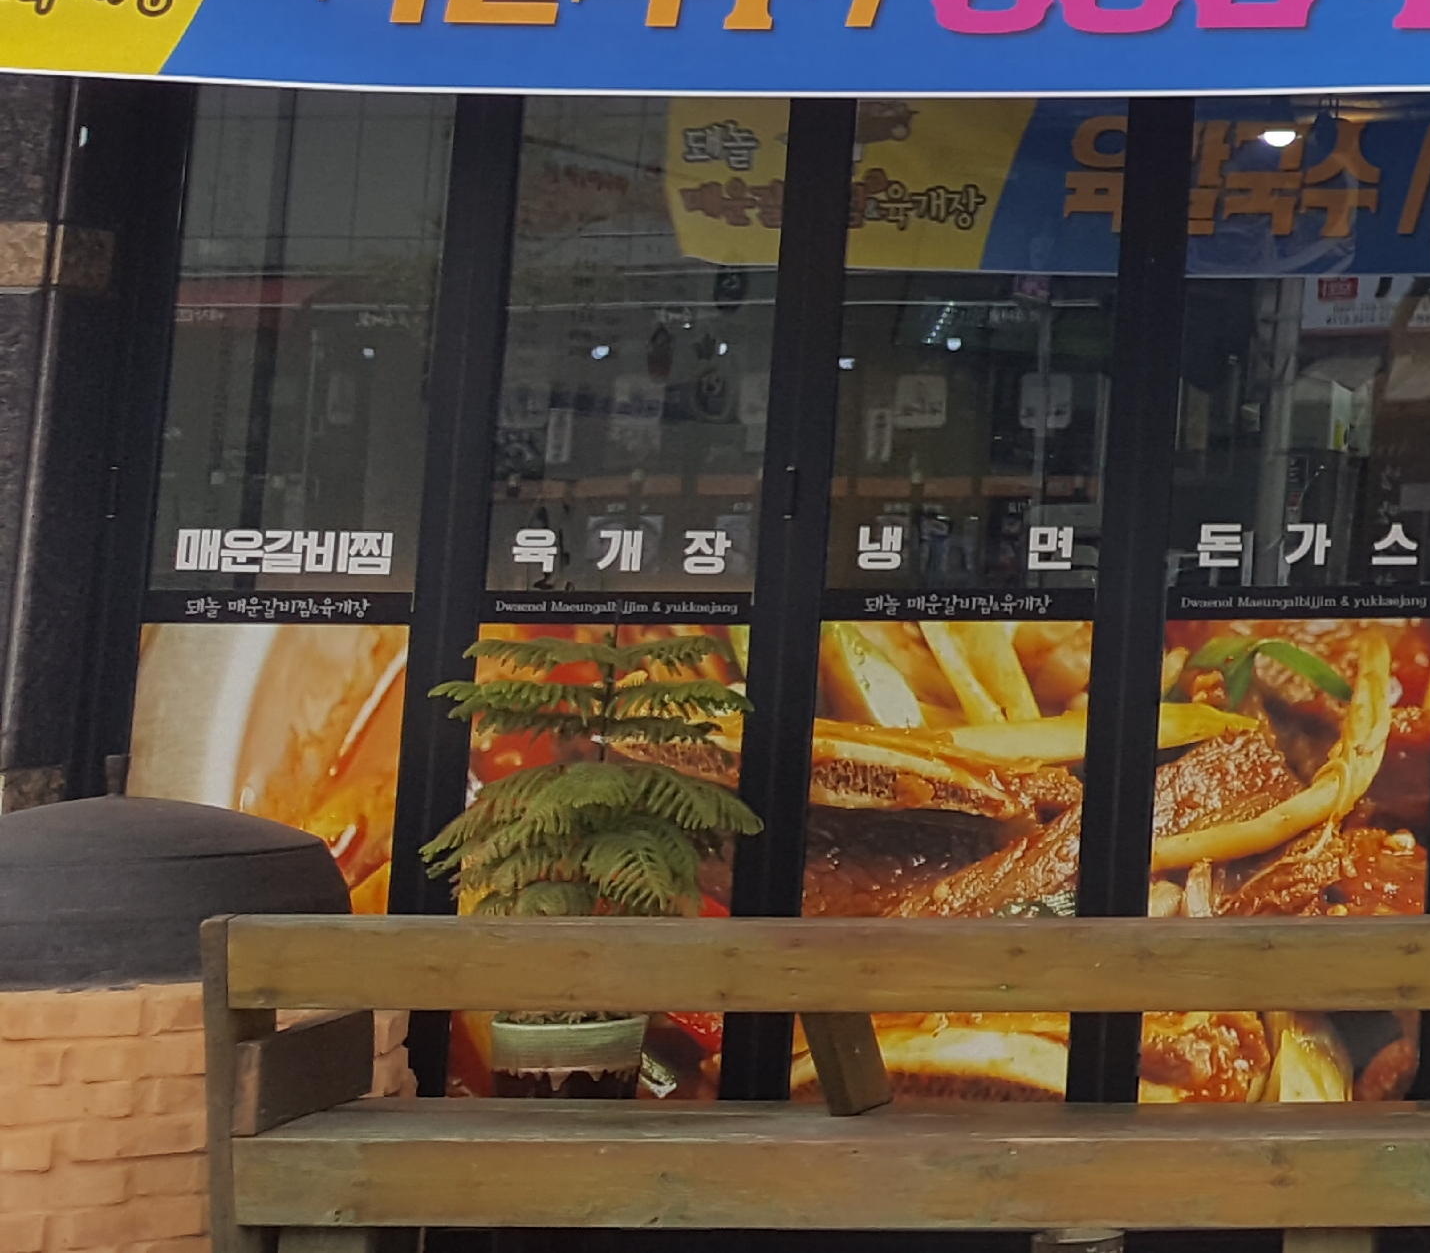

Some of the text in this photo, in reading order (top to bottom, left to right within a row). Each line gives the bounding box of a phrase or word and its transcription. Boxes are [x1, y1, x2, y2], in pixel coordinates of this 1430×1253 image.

[174, 527, 394, 575] 매운갈비찜
[185, 597, 221, 618] 돼놀
[652, 601, 662, 613] &
[864, 594, 901, 616] 돼놀
[1340, 595, 1350, 608] &
